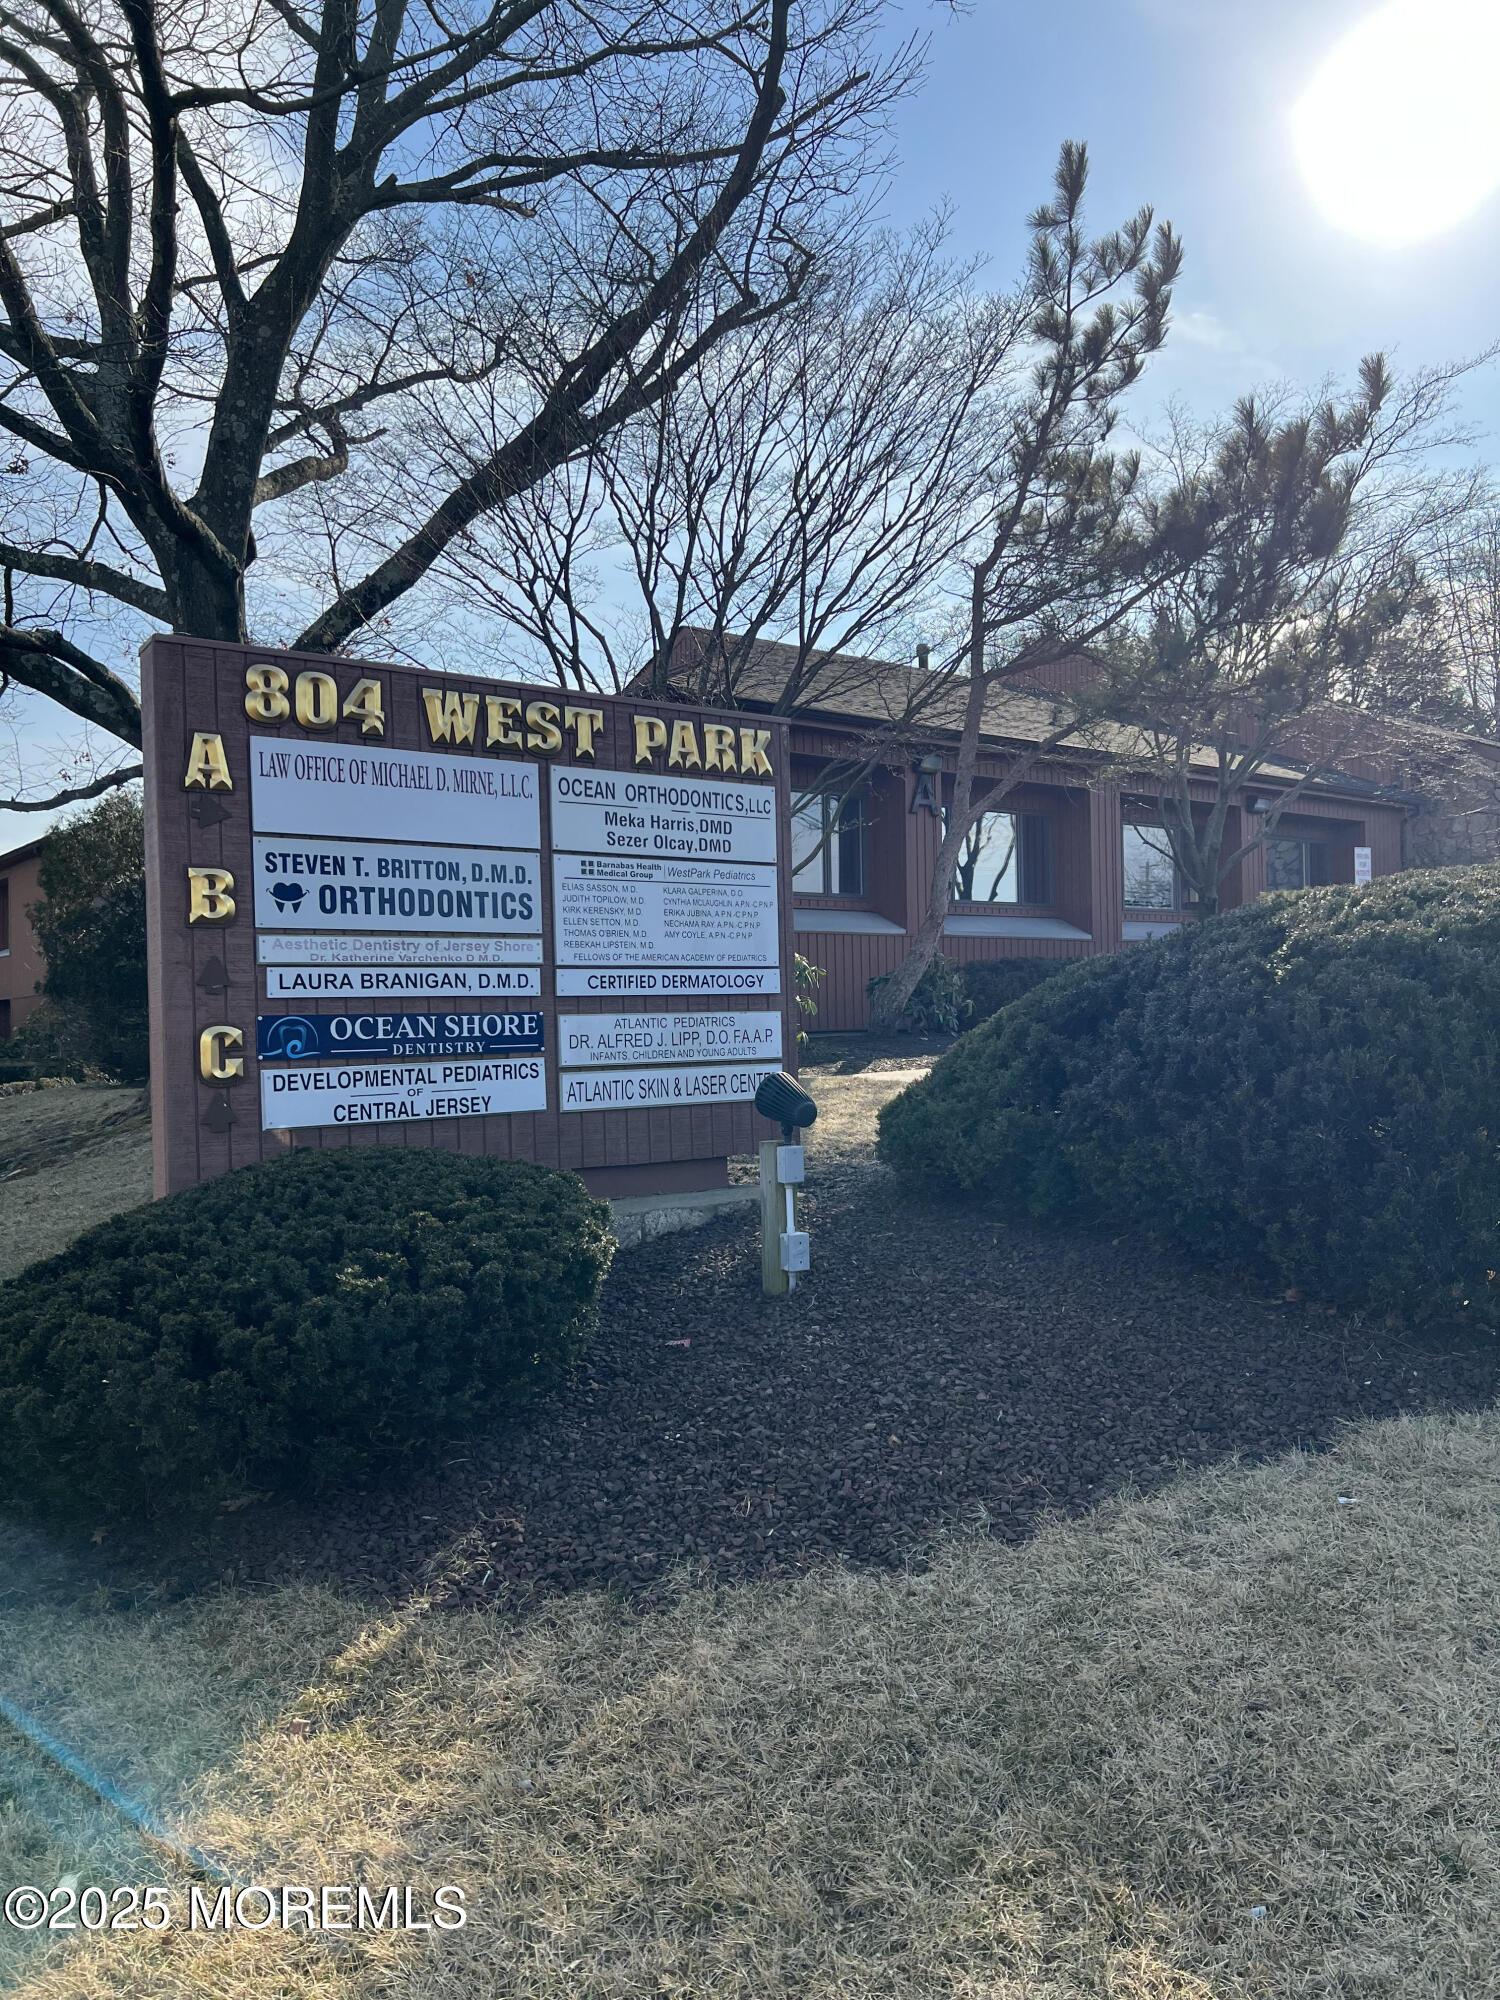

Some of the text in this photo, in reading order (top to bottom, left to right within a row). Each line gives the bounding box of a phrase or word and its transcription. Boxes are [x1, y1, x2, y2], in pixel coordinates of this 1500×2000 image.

[244, 663, 774, 777] 804 WEST PARK
[184, 731, 233, 791] A
[258, 751, 533, 800] LAW OFFICE OF MICHAEL D. MIRNE, L.L.C.
[558, 777, 616, 800] OCEAN
[604, 811, 645, 828] Meka
[606, 831, 649, 848] Sezer
[264, 852, 533, 885] STEVEN T. BRITTON, D.M.D.
[597, 860, 756, 881] Barnabas Health WestPark Pediatrics
[597, 869, 654, 880] Medical Group
[562, 883, 585, 891] ELIAS
[188, 867, 236, 924] B
[318, 884, 533, 920] ORTHODONTICS
[562, 894, 590, 903] JUDITH
[562, 906, 581, 914] KIRK
[663, 909, 686, 917] ERIKA
[563, 917, 588, 926] ELLEN
[664, 920, 700, 928] NECHAMA
[564, 929, 597, 937] THOMAS
[664, 931, 680, 939] AMY
[272, 938, 534, 954] Aesthetic Dentistry of Jersey Shore
[563, 940, 600, 949] REBEKAH
[309, 953, 327, 962] Dr.
[331, 953, 395, 962] Katherine
[398, 954, 463, 962] Varchenko
[573, 953, 767, 962] FELLOWS OF THE AMERICAN ACADEMY OF PEDIATRICS
[278, 973, 534, 992] LAURA BRANIGAN, D.M.D.
[587, 974, 764, 989] CERTIFIED DERMATOLOGY
[330, 1014, 539, 1041] OCEAN SHORE
[614, 1016, 736, 1029] ATLANTIC PEDIATRICS
[569, 1034, 594, 1049] DR.
[597, 1033, 654, 1049] ALFRED
[656, 1032, 668, 1047] J.
[671, 1031, 702, 1047] LIPP,
[200, 1025, 244, 1082] C
[393, 1042, 486, 1056] DENTISTRY
[632, 1049, 676, 1060] CHILDREN
[677, 1048, 695, 1059] AND
[696, 1047, 726, 1058] YOUNG
[727, 1046, 758, 1057] ADULTS
[272, 1062, 540, 1093] DEVELOPMENTAL PEDIATRICS
[407, 1088, 424, 1097] OF
[567, 1079, 635, 1103] ATLANTIC
[638, 1077, 669, 1100] SKIN
[673, 1076, 683, 1098] &
[685, 1074, 728, 1097] LASER
[333, 1095, 492, 1122] CENTRAL JERSEY
